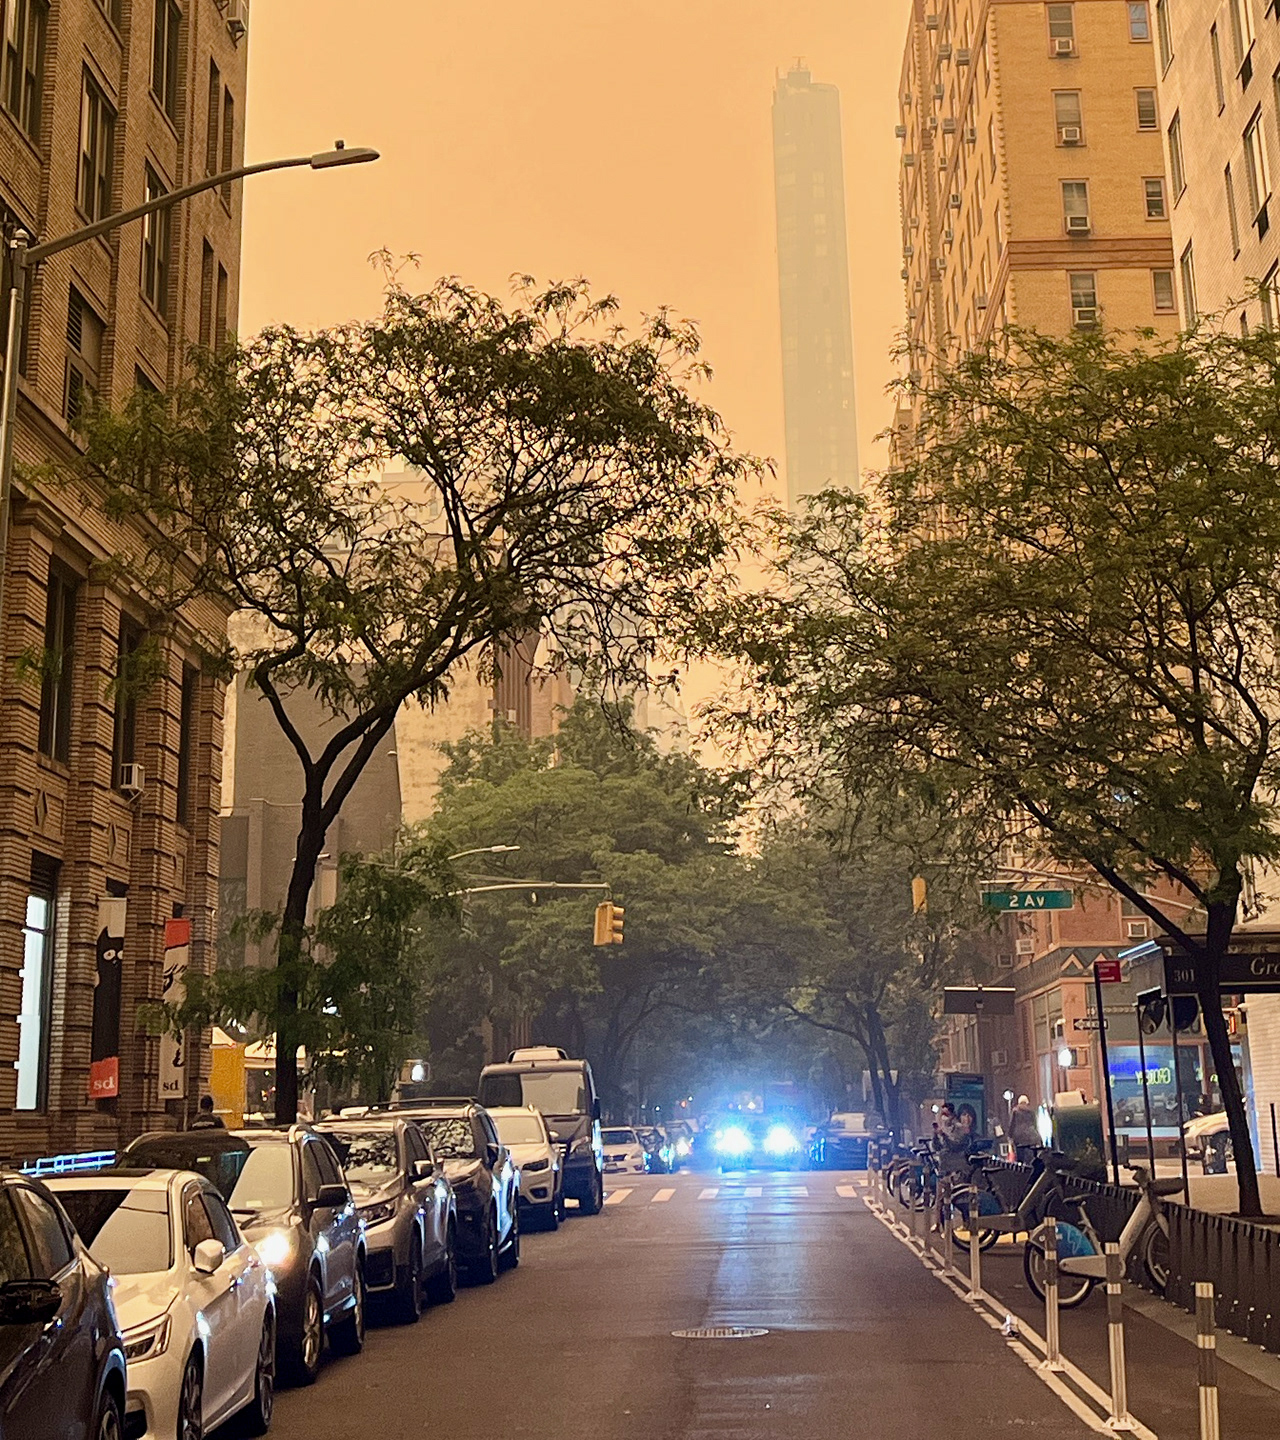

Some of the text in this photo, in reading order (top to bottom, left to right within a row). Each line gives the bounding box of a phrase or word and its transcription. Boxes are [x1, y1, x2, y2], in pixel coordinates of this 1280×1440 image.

[1009, 894, 1045, 908] 2 Av
[1173, 968, 1195, 983] 301
[93, 1076, 116, 1090] sd
[163, 1079, 179, 1091] sd
